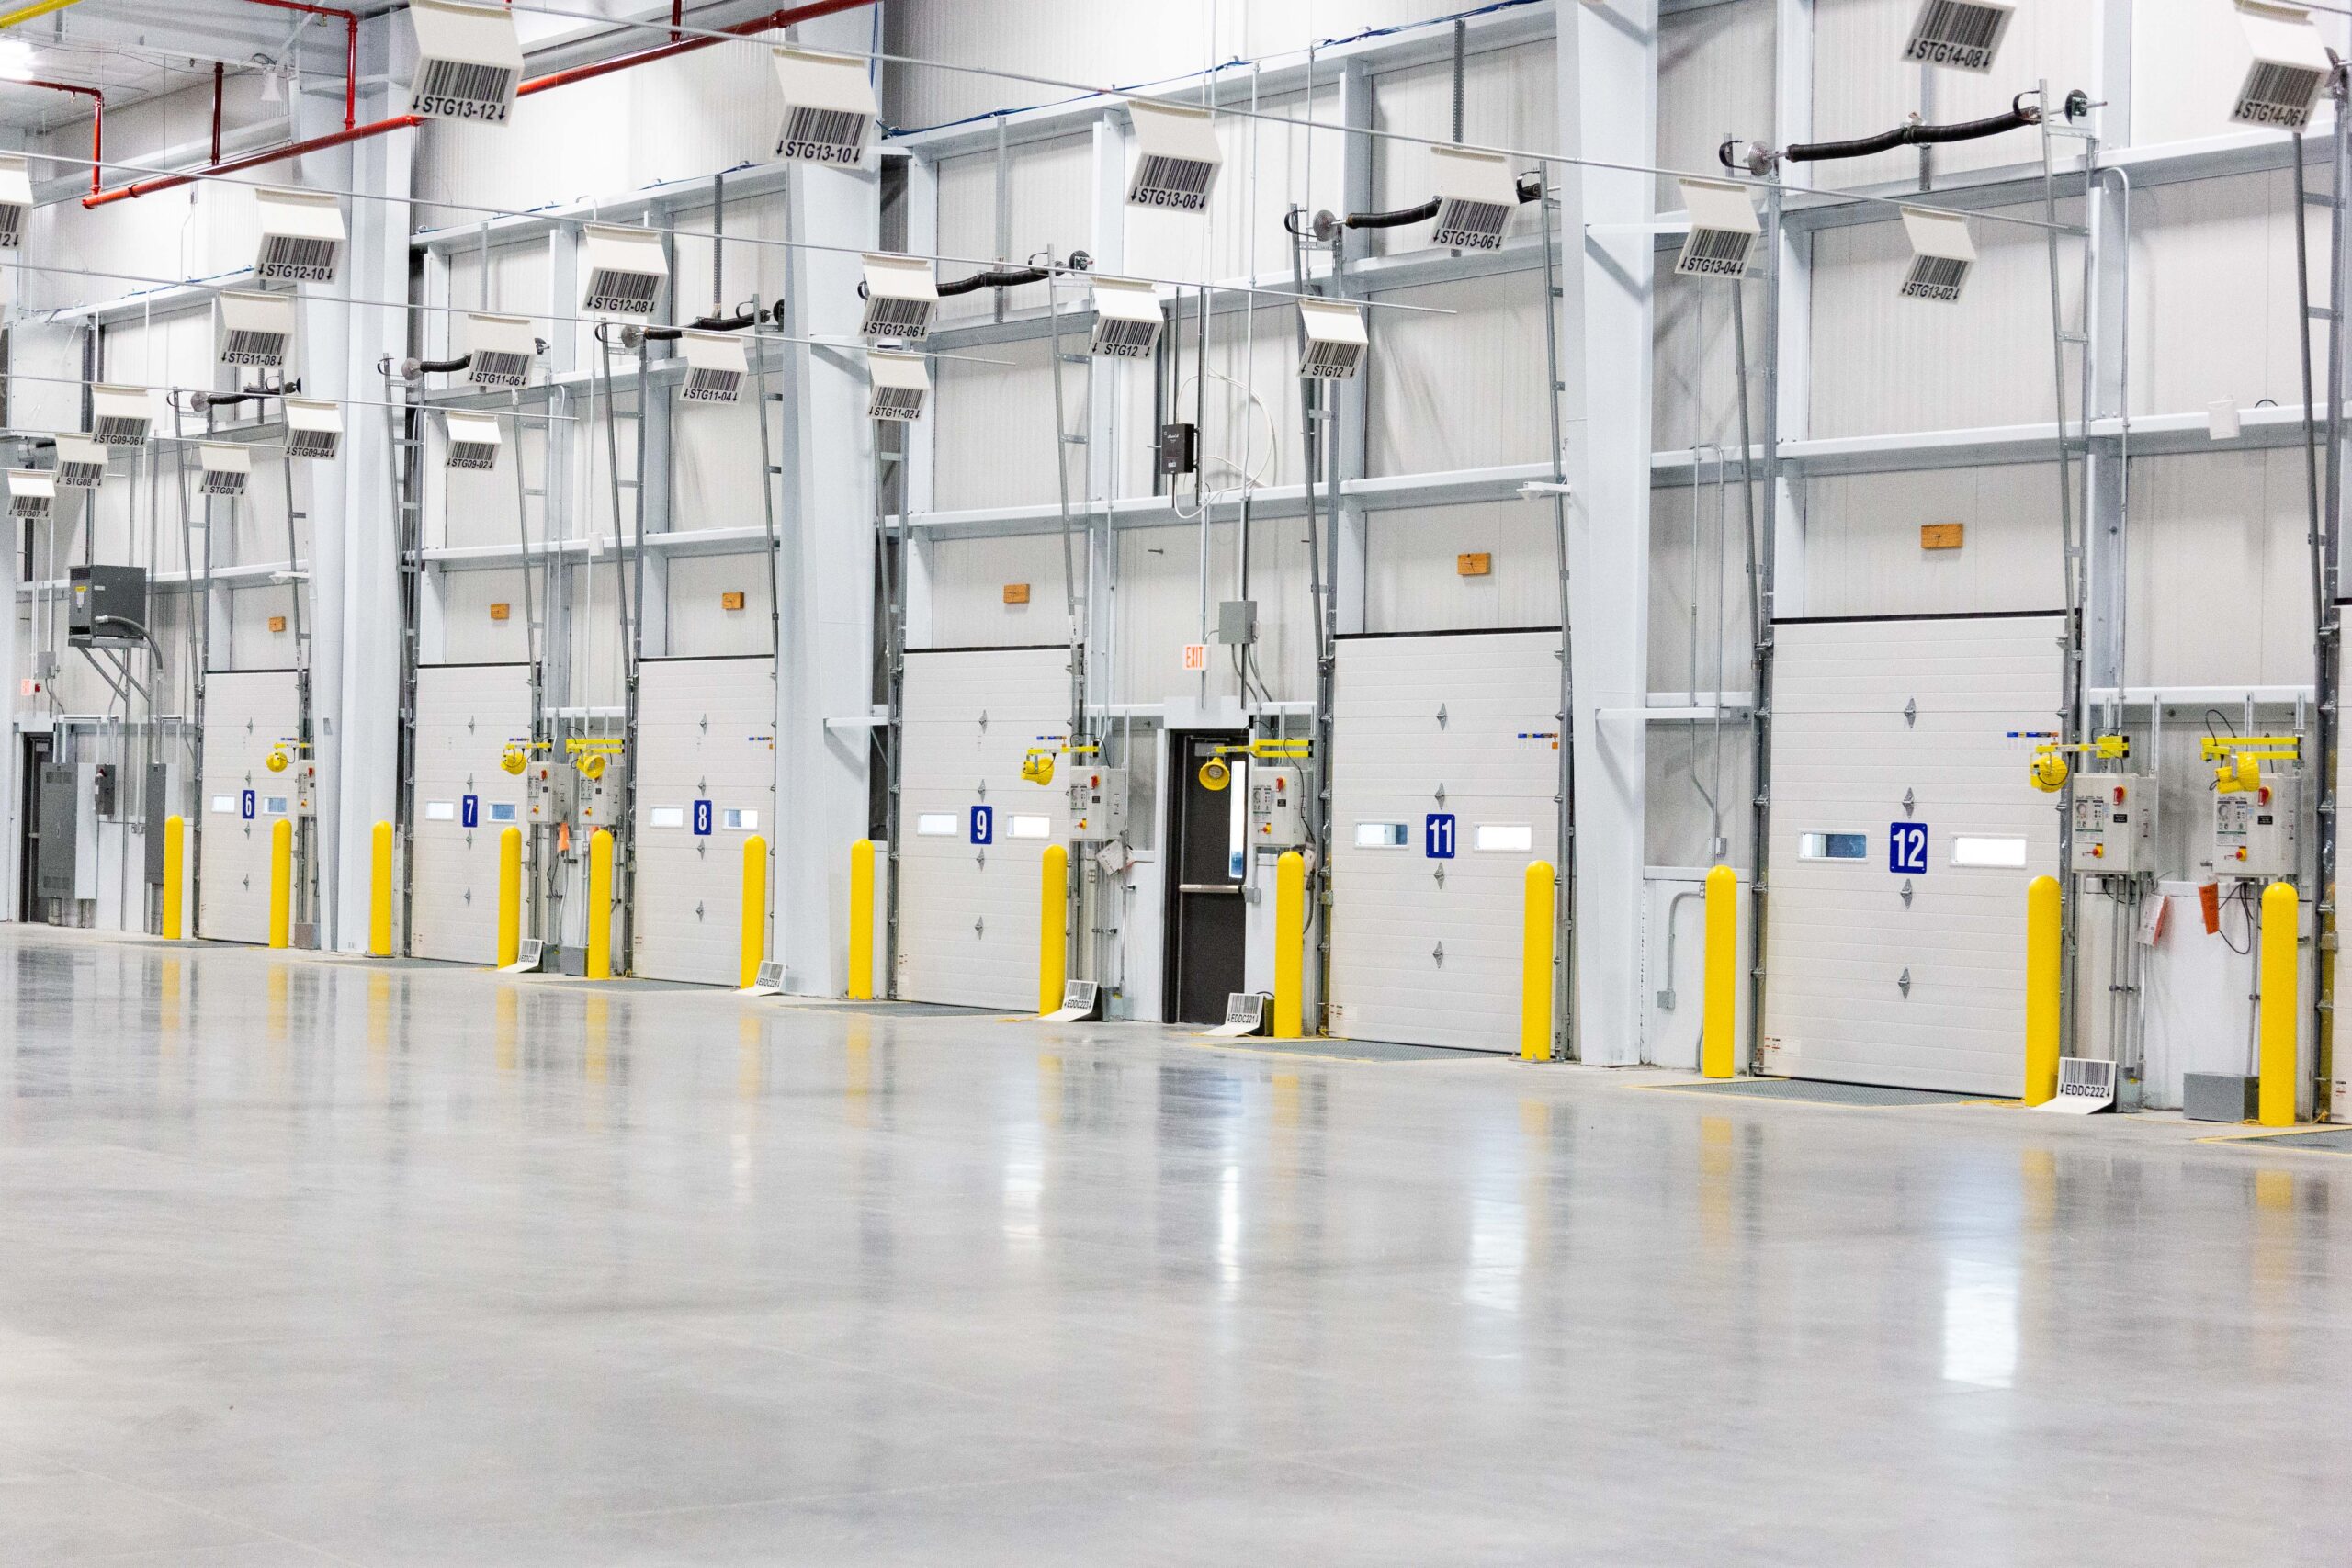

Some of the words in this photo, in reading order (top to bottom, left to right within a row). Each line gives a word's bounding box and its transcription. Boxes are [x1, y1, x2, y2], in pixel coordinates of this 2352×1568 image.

[1916, 41, 1982, 68] STG14-08
[423, 97, 494, 120] STG13-12
[2242, 102, 2300, 126] STG14-06
[786, 142, 851, 163] STG13-10
[1138, 188, 1196, 209] STG13-08
[1441, 230, 1494, 249] STG13-06
[266, 265, 324, 280] STG12-10
[1688, 258, 1735, 274] STG13-04
[1907, 283, 1952, 300] STG13-02
[594, 297, 649, 312] STG12-08
[870, 323, 919, 337] STG12-06
[1104, 344, 1138, 356] STG12
[229, 353, 276, 366] STG11-08
[476, 372, 521, 386] STG11-06
[1312, 365, 1343, 378] STG12
[689, 389, 731, 401] STG11-04
[875, 407, 914, 419] STG11-02
[99, 434, 140, 446] STG09-06
[291, 447, 329, 457] STG09-04
[451, 458, 488, 469] STG09-02
[66, 479, 91, 487] STG08
[210, 487, 234, 495] STG08
[1186, 647, 1204, 668] EXIT
[245, 793, 252, 816] 6
[467, 799, 474, 823] 7
[698, 804, 707, 831] 8
[977, 810, 987, 840] 9
[1430, 819, 1452, 852] 11
[1893, 829, 1924, 867] 12
[2066, 1084, 2105, 1098] EDDC222
